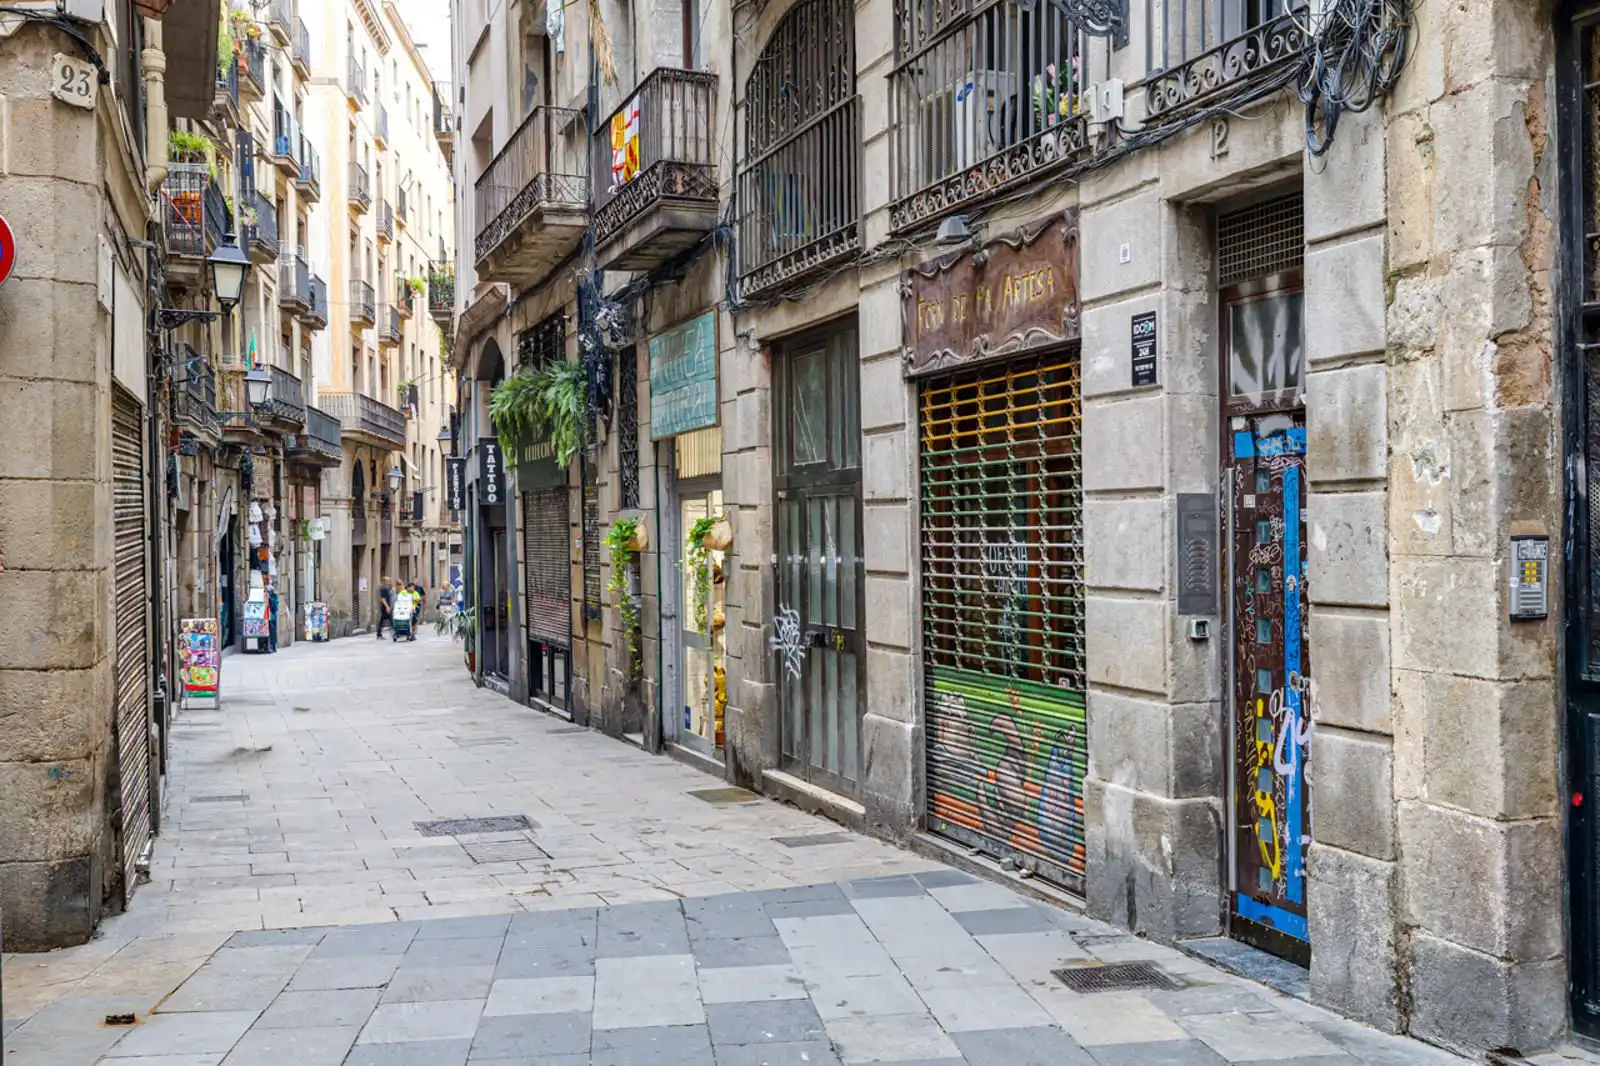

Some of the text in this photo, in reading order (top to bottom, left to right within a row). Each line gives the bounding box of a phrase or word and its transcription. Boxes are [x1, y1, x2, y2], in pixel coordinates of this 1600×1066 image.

[61, 64, 90, 97] 23
[1209, 118, 1230, 160] 12
[452, 463, 460, 509] PIERCING
[486, 444, 497, 503] TATTOO
